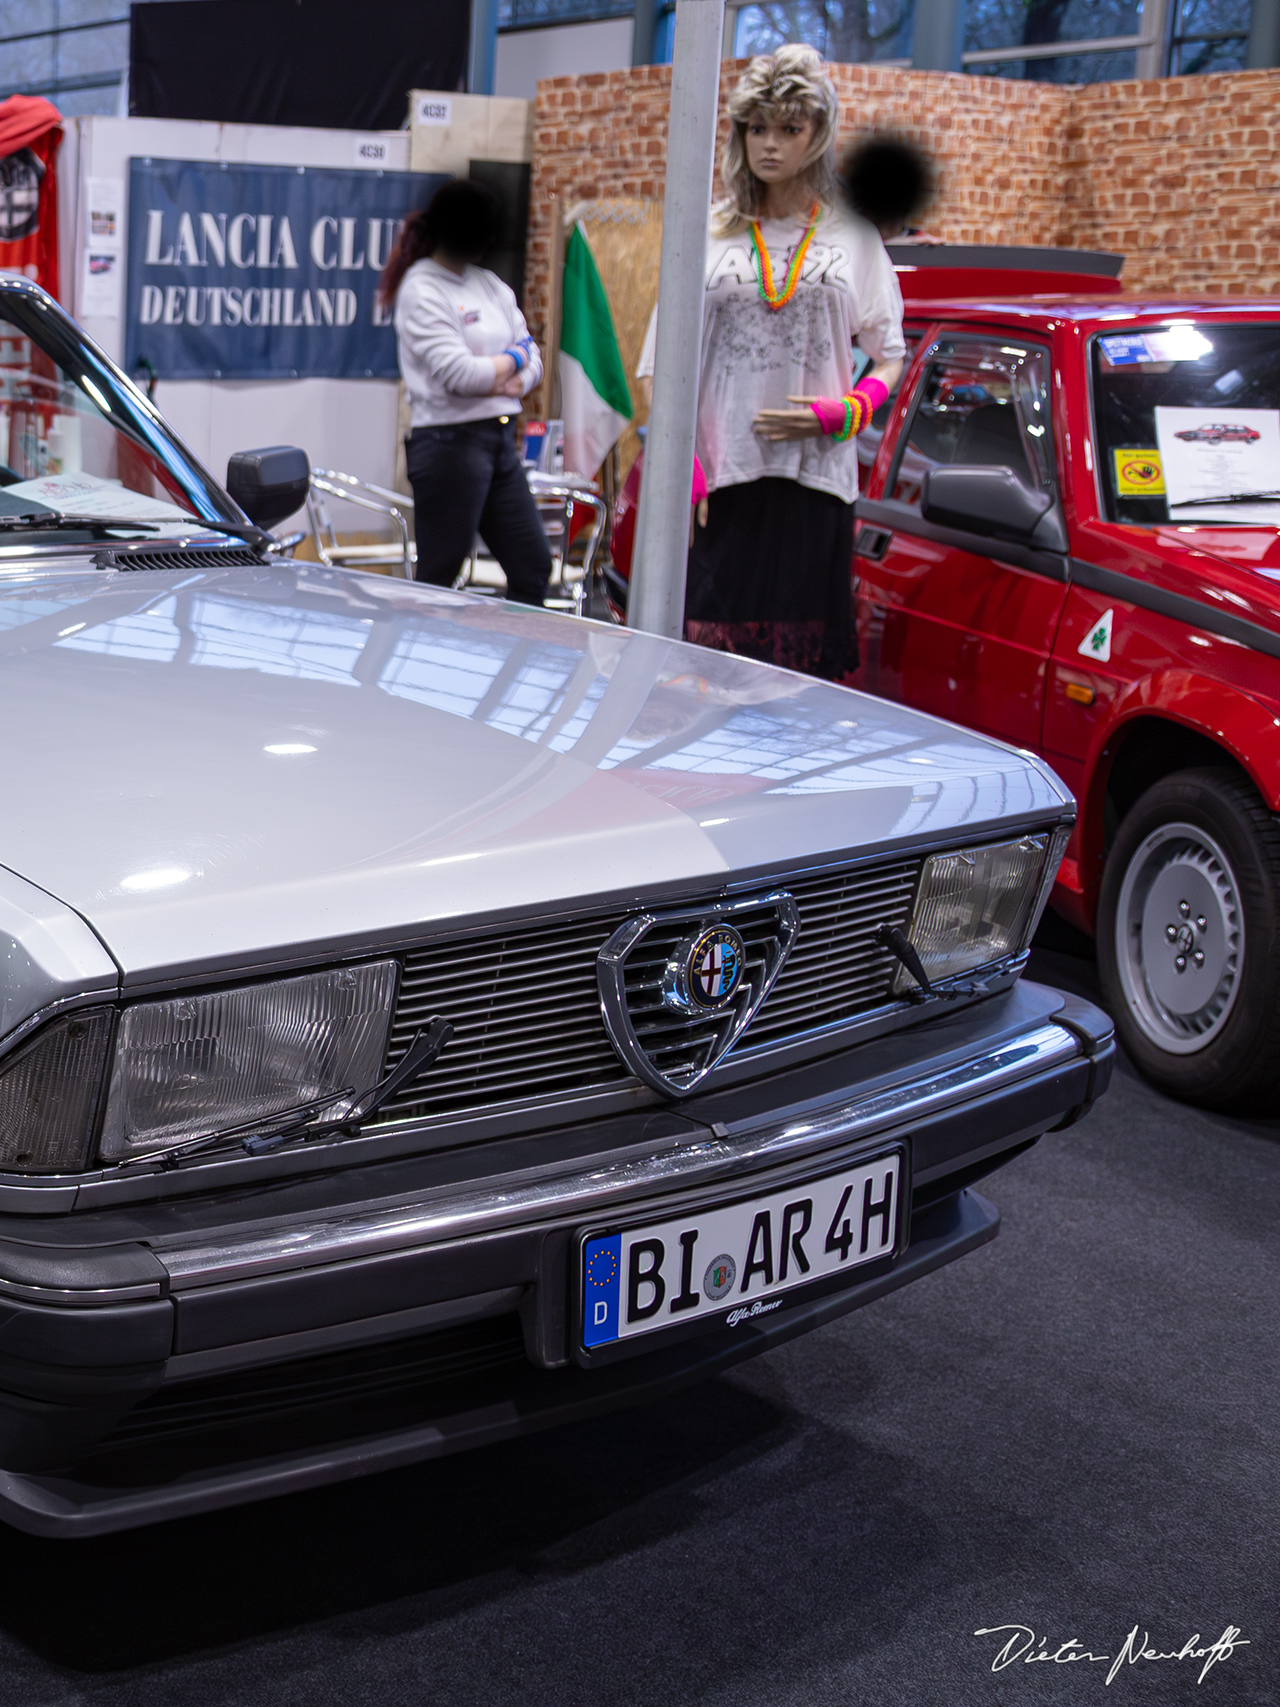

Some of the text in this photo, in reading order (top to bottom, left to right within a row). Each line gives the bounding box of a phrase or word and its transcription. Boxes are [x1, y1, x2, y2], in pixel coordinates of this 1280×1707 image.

[144, 209, 407, 271] LANCIA CLU
[139, 284, 358, 327] DEUTSCHLAND
[693, 934, 742, 975] ALFA ROMEO
[626, 1228, 700, 1325] BI
[739, 1197, 814, 1293] AR
[824, 1171, 894, 1262] 4H
[594, 1301, 608, 1326] D
[726, 1299, 783, 1328] Alfa Romeo
